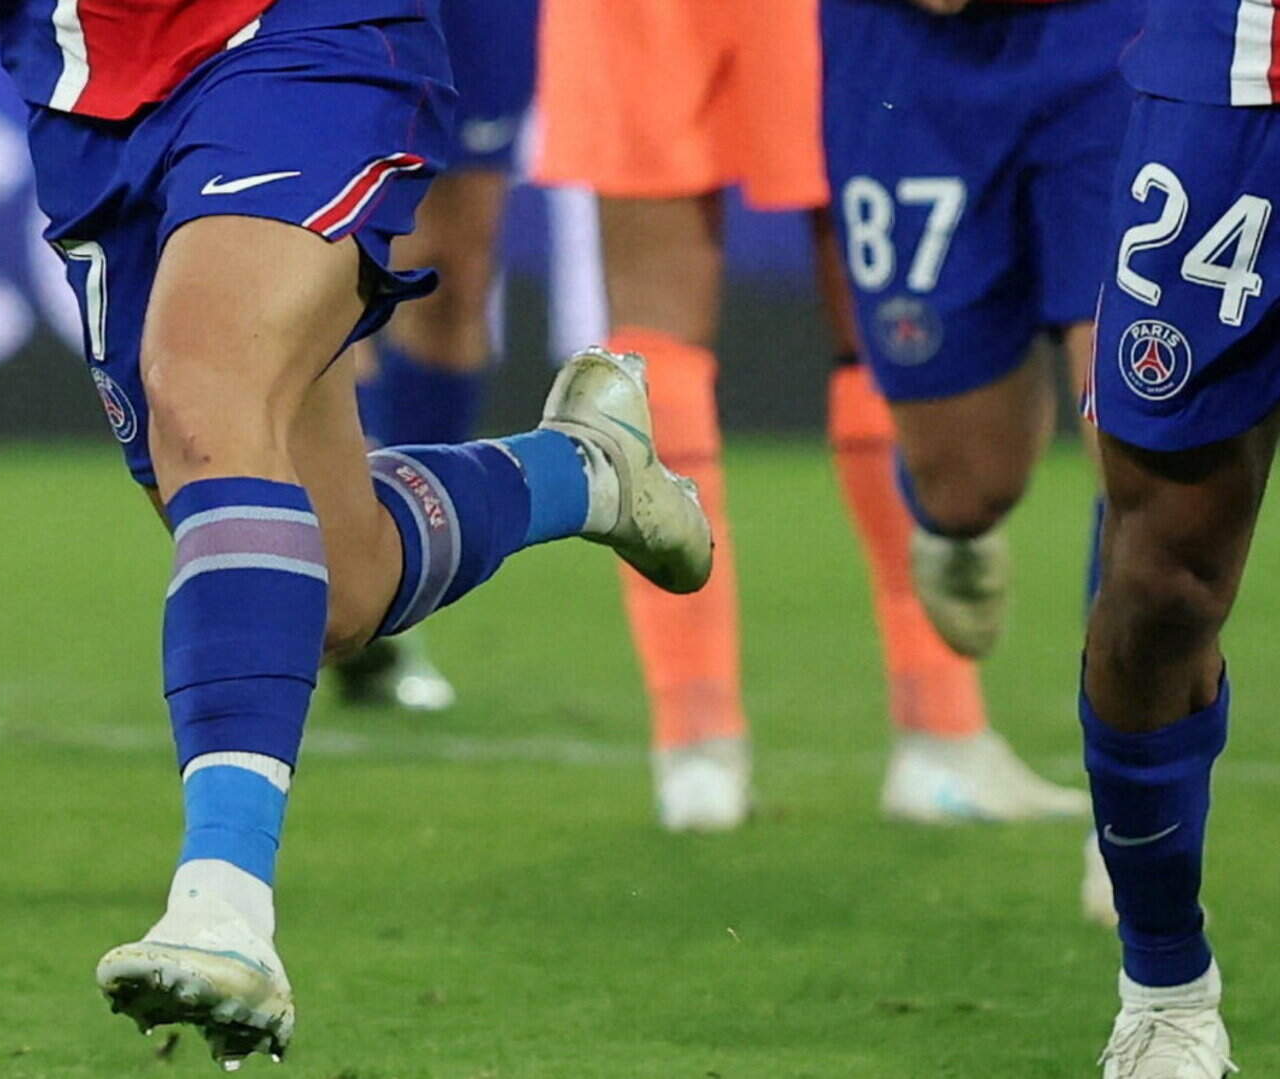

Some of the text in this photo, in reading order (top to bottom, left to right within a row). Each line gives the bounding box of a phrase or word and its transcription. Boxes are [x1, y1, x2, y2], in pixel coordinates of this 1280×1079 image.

[844, 176, 968, 292] 87
[1116, 162, 1272, 327] 24
[1130, 324, 1180, 347] PARIS
